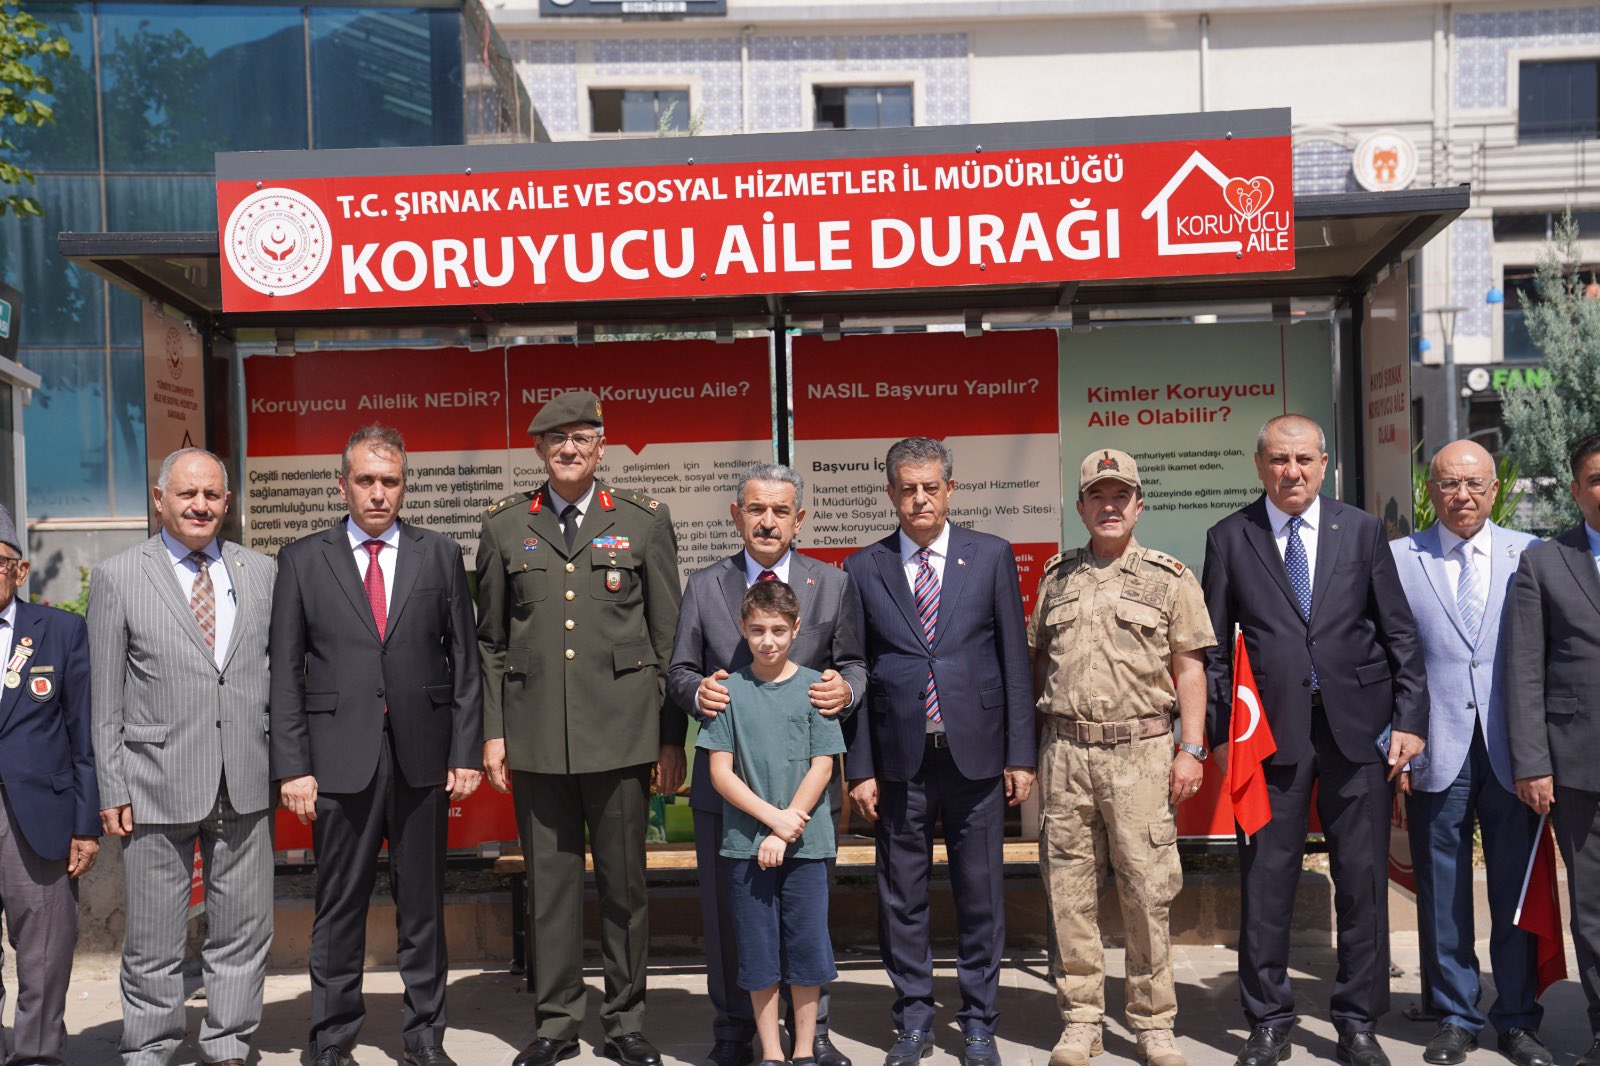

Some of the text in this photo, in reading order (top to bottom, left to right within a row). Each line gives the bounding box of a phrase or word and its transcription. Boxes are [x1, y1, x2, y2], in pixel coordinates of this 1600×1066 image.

[336, 152, 1124, 222] T.C. ŞIRNAK AİLE VE SOSYAL HİZMETLER İL MÜDÜRLÜĞÜ
[1176, 211, 1290, 236] KORUYUCU
[341, 197, 1120, 295] KORUYUCU AİLE DURAĞI
[1246, 228, 1289, 252] AİLE
[600, 385, 695, 404] Koruyucu
[700, 381, 751, 399] Aile?
[807, 378, 1040, 400] NASIL Başvuru Yapılır?
[1087, 383, 1276, 403] Kimler Koruyucu
[251, 388, 501, 416] Koruyucu Ailelik NEDİR?
[1088, 406, 1232, 428] Aile Olabilir?
[1178, 449, 1221, 459] vatandaşı
[1223, 449, 1245, 457] olan,
[249, 470, 279, 484] Çeşitli
[281, 469, 331, 480] nedenlerle
[417, 465, 455, 479] yanında
[458, 464, 502, 476] bakımları
[622, 461, 670, 474] gelişimleri
[683, 461, 700, 472] için
[812, 461, 869, 474] Başvuru
[1167, 463, 1197, 472] ikamet
[1199, 463, 1224, 471] eden,
[612, 472, 682, 484] destekleyecek,
[684, 472, 715, 483] sosyal
[250, 486, 324, 500] sağlanamayan
[436, 484, 448, 492] ve
[450, 481, 504, 494] yetiştirilme
[651, 485, 677, 494] sıcak
[679, 485, 691, 493] bir
[694, 483, 711, 493] aile
[713, 482, 740, 492] ortam
[812, 483, 848, 494] İkamet
[989, 480, 1040, 489] Hizmetler
[1147, 488, 1192, 499] düzeyinde
[1194, 487, 1222, 498] eğitim
[1223, 487, 1247, 496] almış
[250, 502, 325, 515] sorumluluğunu
[406, 500, 431, 509] uzun
[433, 497, 460, 508] süreli
[463, 496, 494, 508] olarak
[822, 496, 877, 508] Müdürlüğü
[1152, 502, 1176, 512] sahip
[1178, 501, 1208, 510] herkes
[812, 510, 833, 520] Aile
[835, 511, 848, 519] ve
[851, 509, 887, 521] Sosyal
[994, 505, 1020, 515] Web
[250, 518, 281, 530] ücretli
[283, 520, 308, 531] veya
[310, 516, 343, 531] gönüll
[426, 513, 482, 525] denetimind
[691, 520, 704, 528] en
[706, 519, 723, 529] çok
[813, 522, 899, 534] www.koruyucuai
[690, 531, 707, 541] gibi
[709, 531, 728, 539] tüm
[813, 535, 857, 545] e-Devlet
[691, 542, 708, 551] aile
